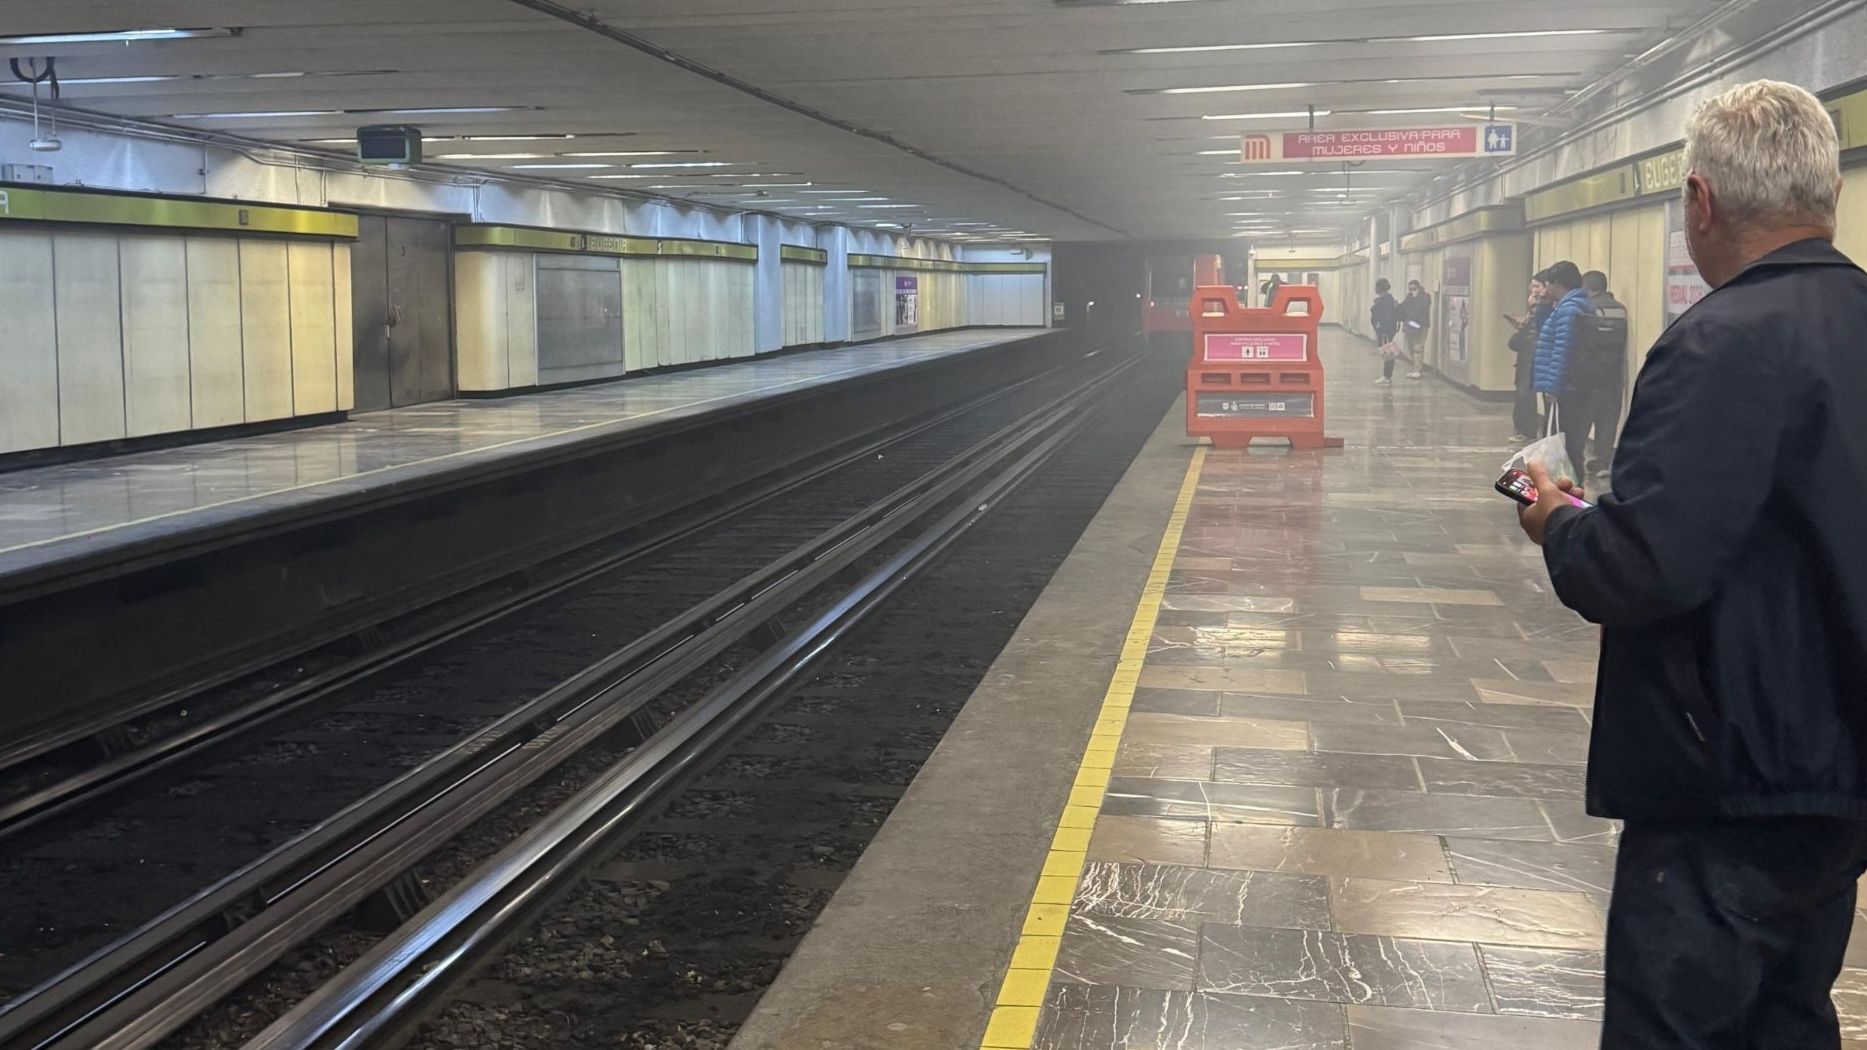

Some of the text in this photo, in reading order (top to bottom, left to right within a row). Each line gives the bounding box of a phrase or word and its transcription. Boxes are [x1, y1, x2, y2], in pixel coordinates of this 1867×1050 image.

[1298, 129, 1461, 144] AREA EXCLUSIVA PARA
[1312, 141, 1446, 156] MUJERES Y NIÑOS
